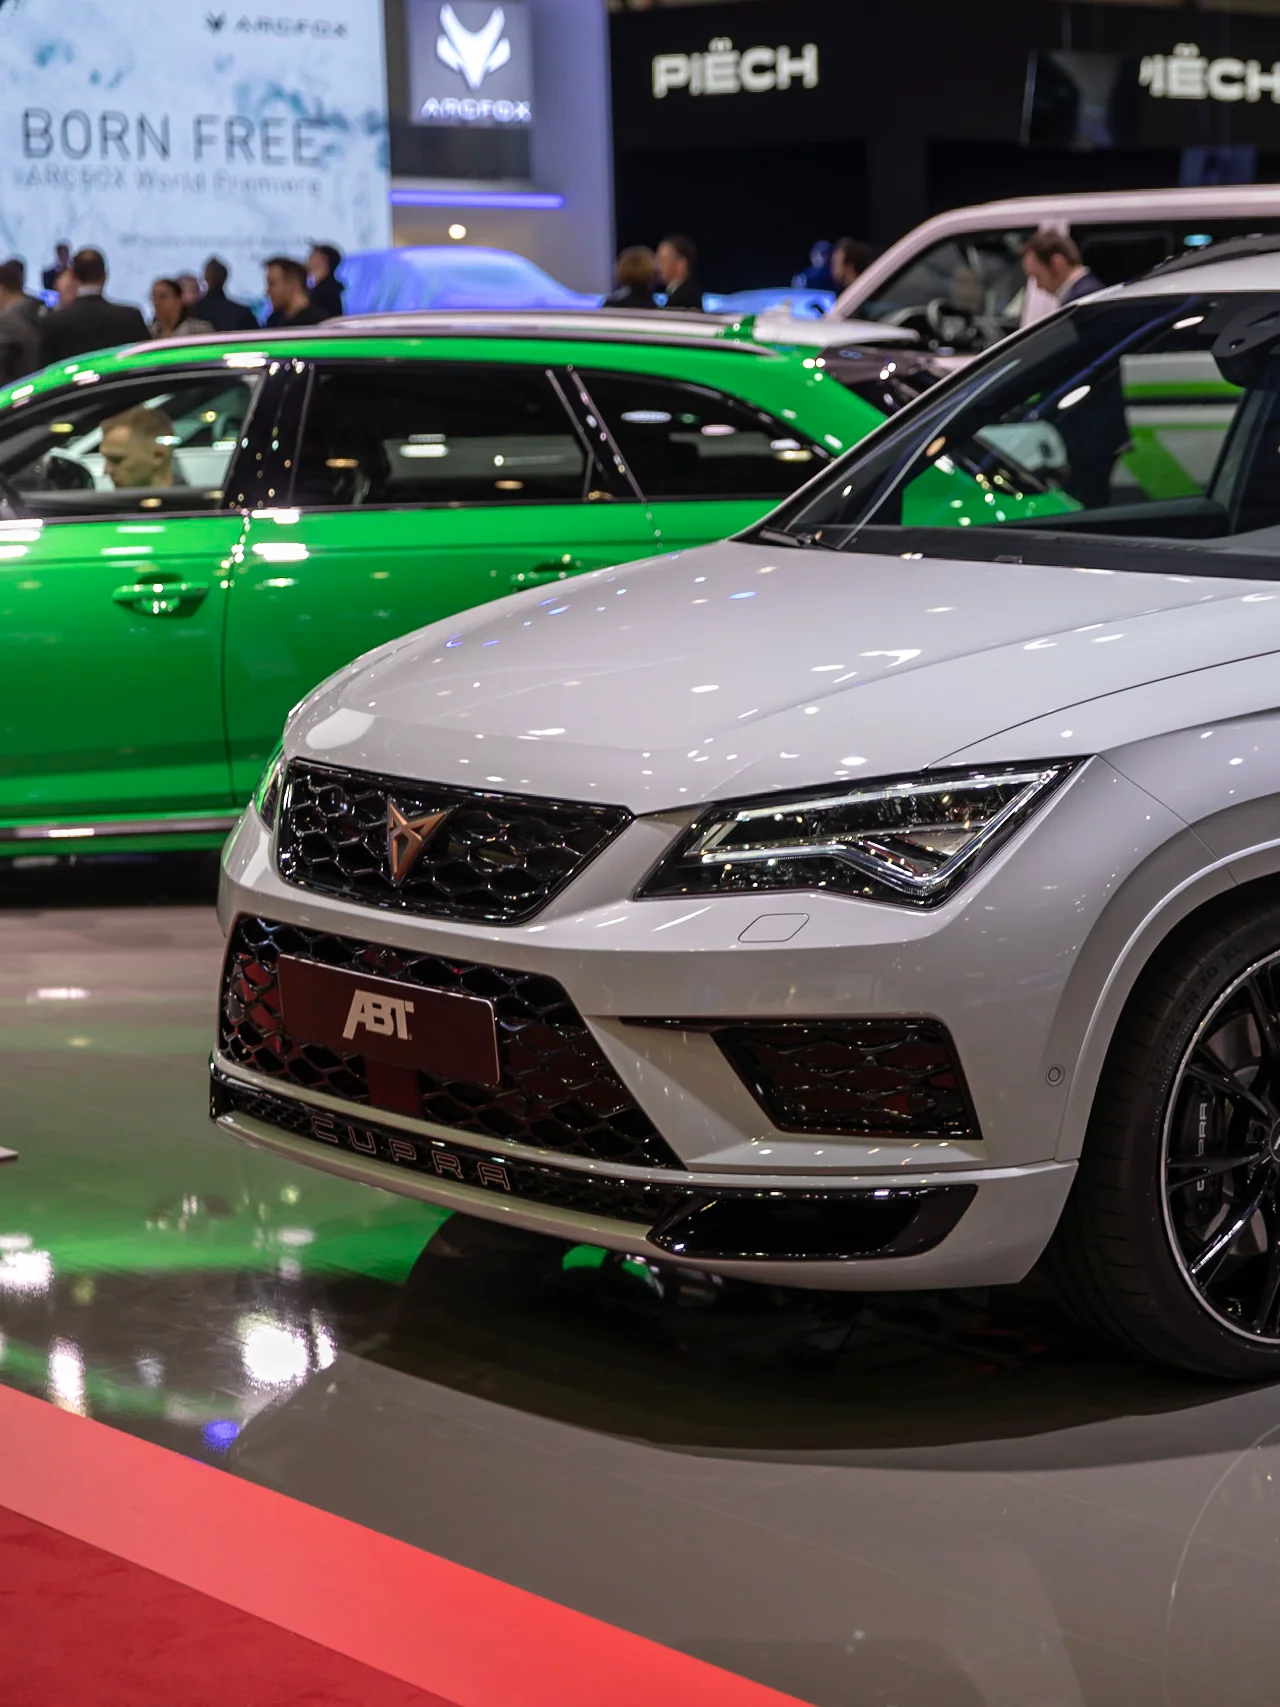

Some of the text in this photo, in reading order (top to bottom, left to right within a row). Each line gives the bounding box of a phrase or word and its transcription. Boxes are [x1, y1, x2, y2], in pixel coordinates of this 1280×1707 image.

[652, 37, 818, 98] PIËCH
[22, 107, 322, 166] BORN FREE
[342, 989, 414, 1041] ABT
[310, 1114, 512, 1190] CUPRA
[1195, 1103, 1208, 1191] CPRA
